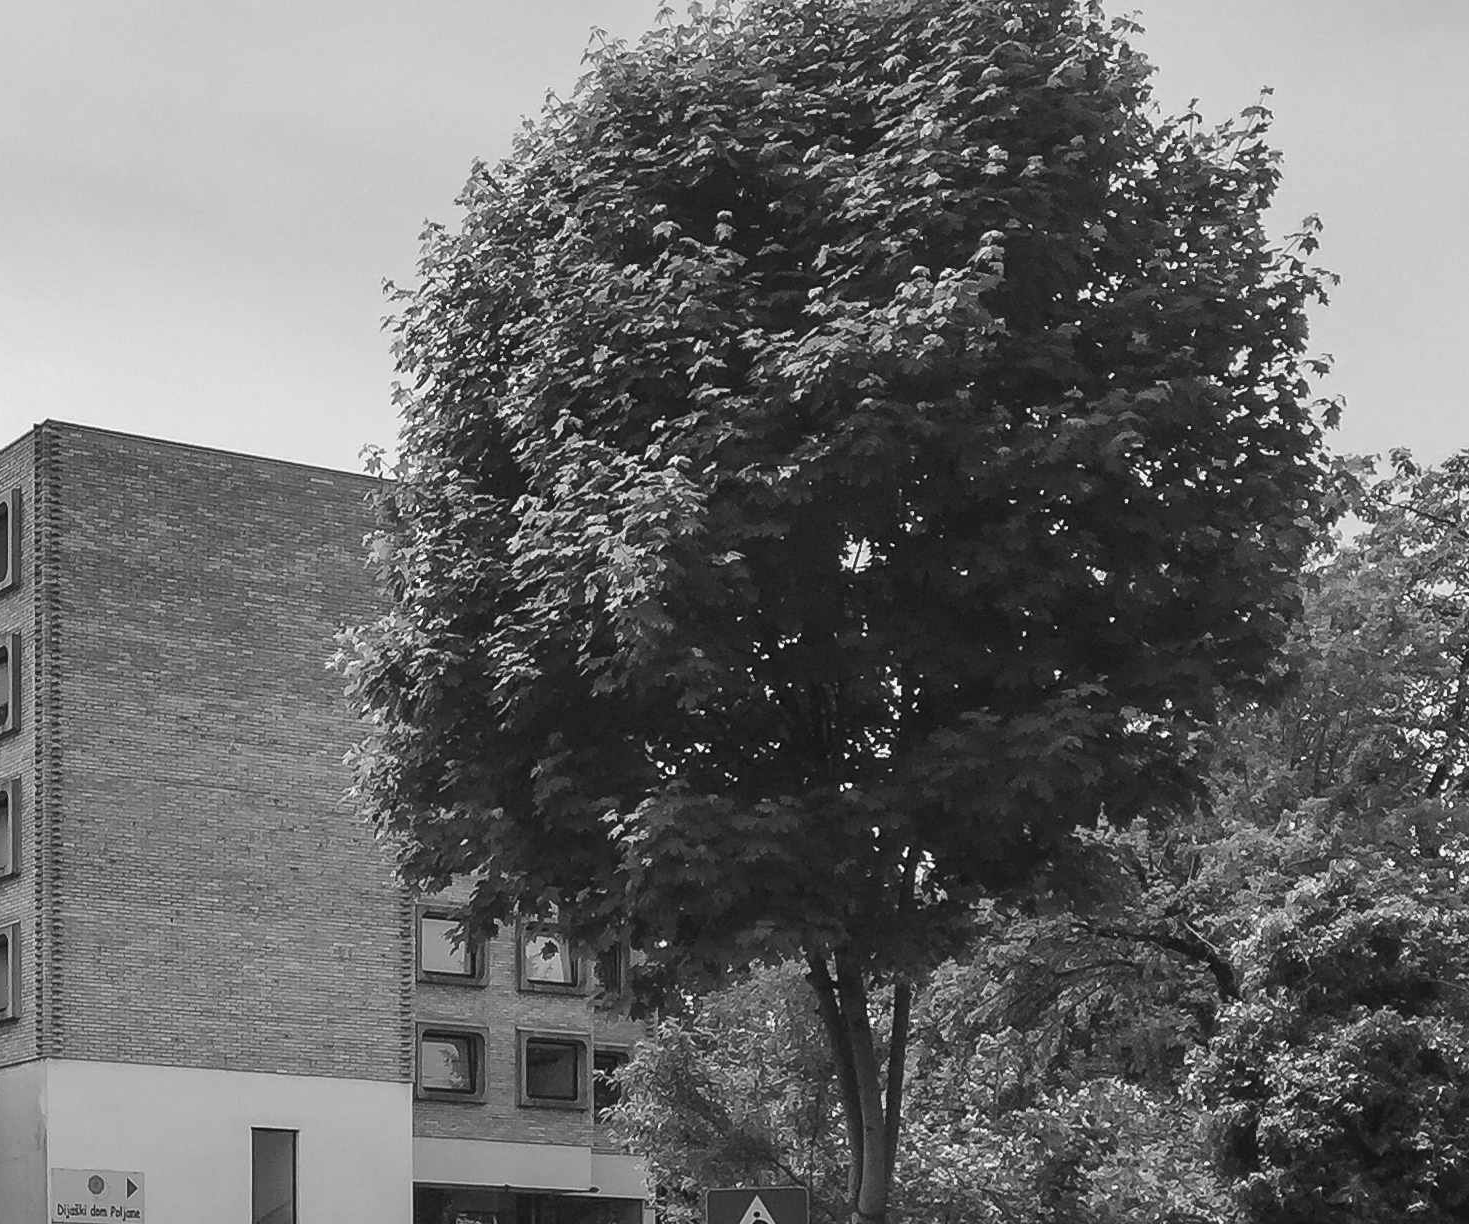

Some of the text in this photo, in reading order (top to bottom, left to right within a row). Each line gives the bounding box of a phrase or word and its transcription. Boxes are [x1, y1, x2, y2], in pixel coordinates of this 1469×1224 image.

[57, 1203, 141, 1222] Dijaški dom Poljane
